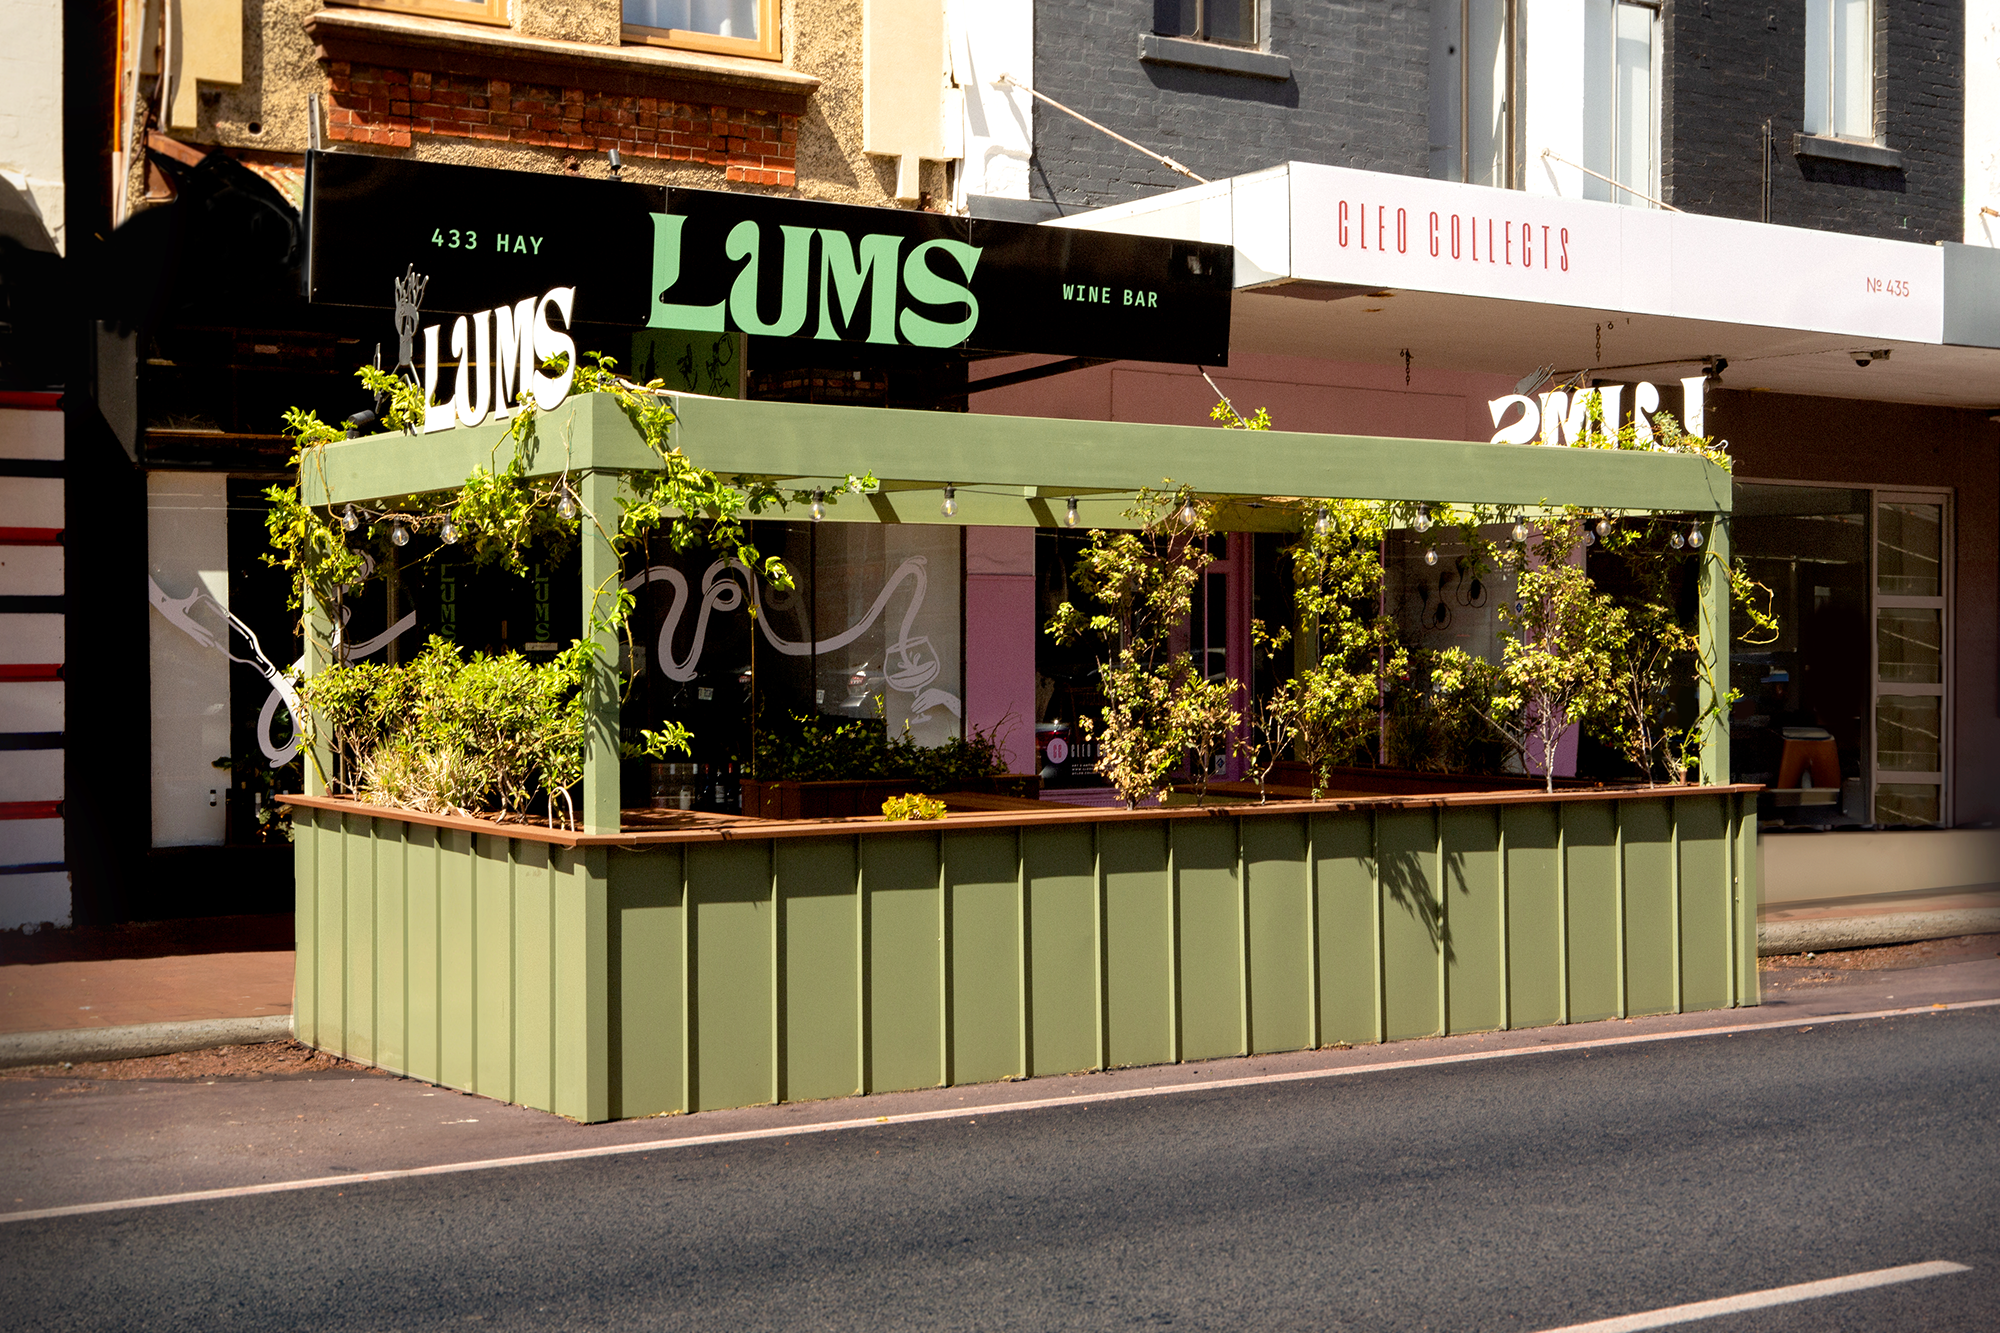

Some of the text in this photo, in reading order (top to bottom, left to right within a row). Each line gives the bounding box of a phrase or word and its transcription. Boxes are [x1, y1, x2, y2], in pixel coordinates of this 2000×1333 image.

[431, 228, 544, 255] 433 HAY
[1339, 200, 1568, 272] CLEO COLLECTS
[646, 212, 984, 348] LUMS
[1062, 283, 1158, 308] WINE BAR
[1886, 279, 1910, 297] 435
[423, 286, 577, 434] LUMS
[440, 563, 456, 642] LUMS
[534, 563, 550, 642] LUMS
